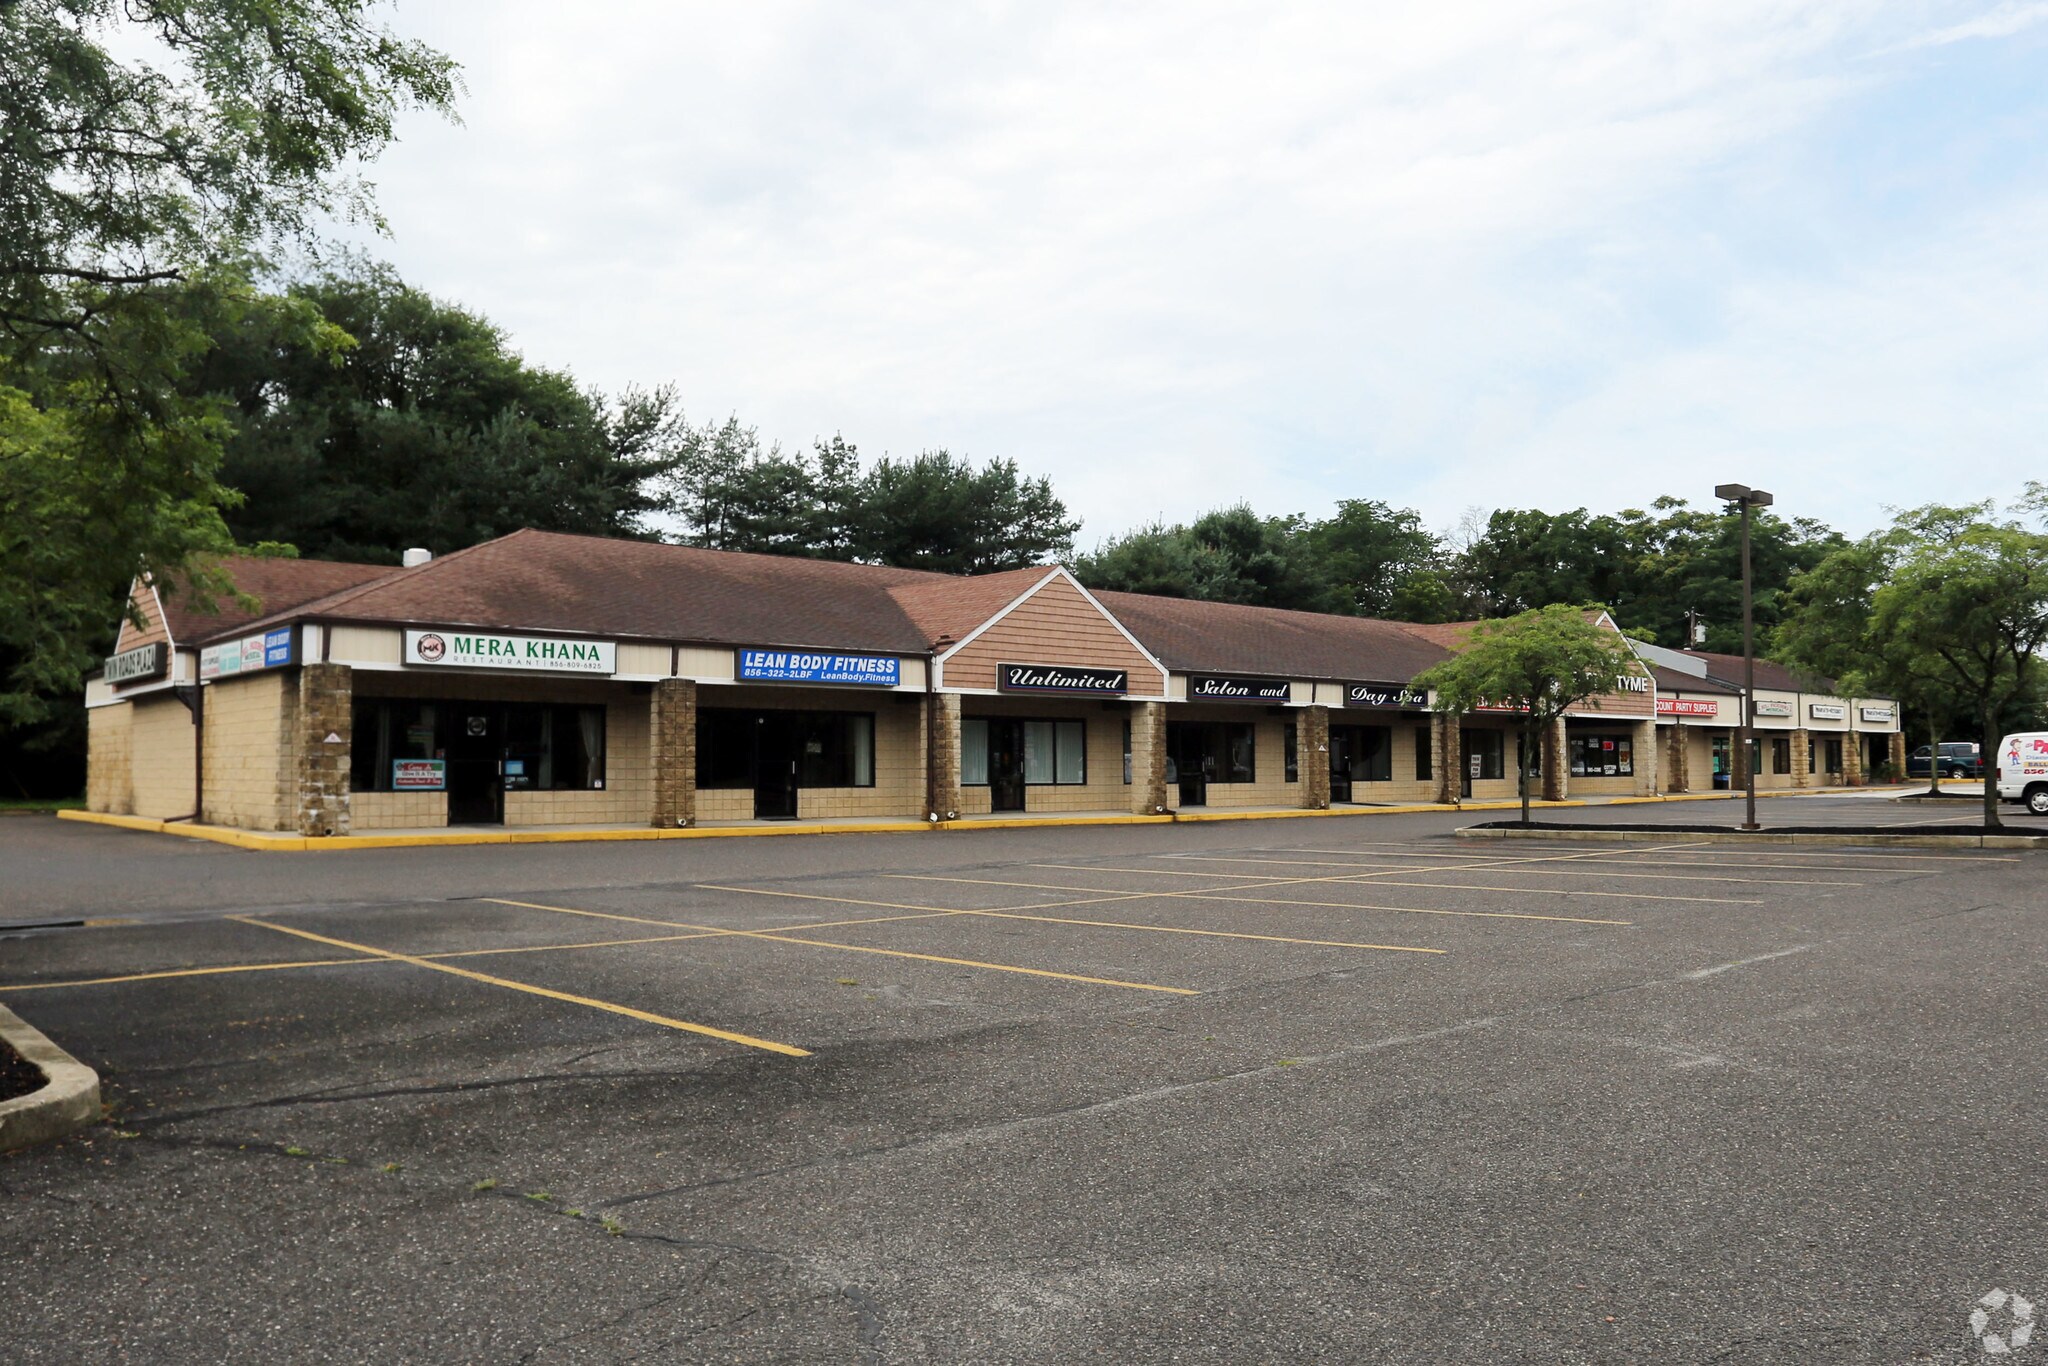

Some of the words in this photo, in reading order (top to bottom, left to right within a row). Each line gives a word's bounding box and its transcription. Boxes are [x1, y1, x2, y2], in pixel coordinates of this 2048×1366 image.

[454, 637, 516, 656] MERA
[526, 641, 600, 661] KHANA
[453, 655, 541, 667] RESTAURANT
[550, 660, 602, 670] 856-809-6825
[745, 652, 787, 668] LEAN
[789, 654, 832, 670] BODY
[834, 657, 895, 673] FITNESS
[744, 668, 812, 679] 856-322-2LBF
[821, 671, 896, 682] LeanBody.Fitness
[1010, 668, 1123, 689] Unlimited
[1616, 675, 1648, 692] TYME
[1195, 680, 1250, 696] Salon
[1260, 684, 1288, 697] and
[1350, 687, 1388, 706] Day
[1675, 702, 1693, 712] PARTY
[1693, 703, 1717, 714] SUPPLIES
